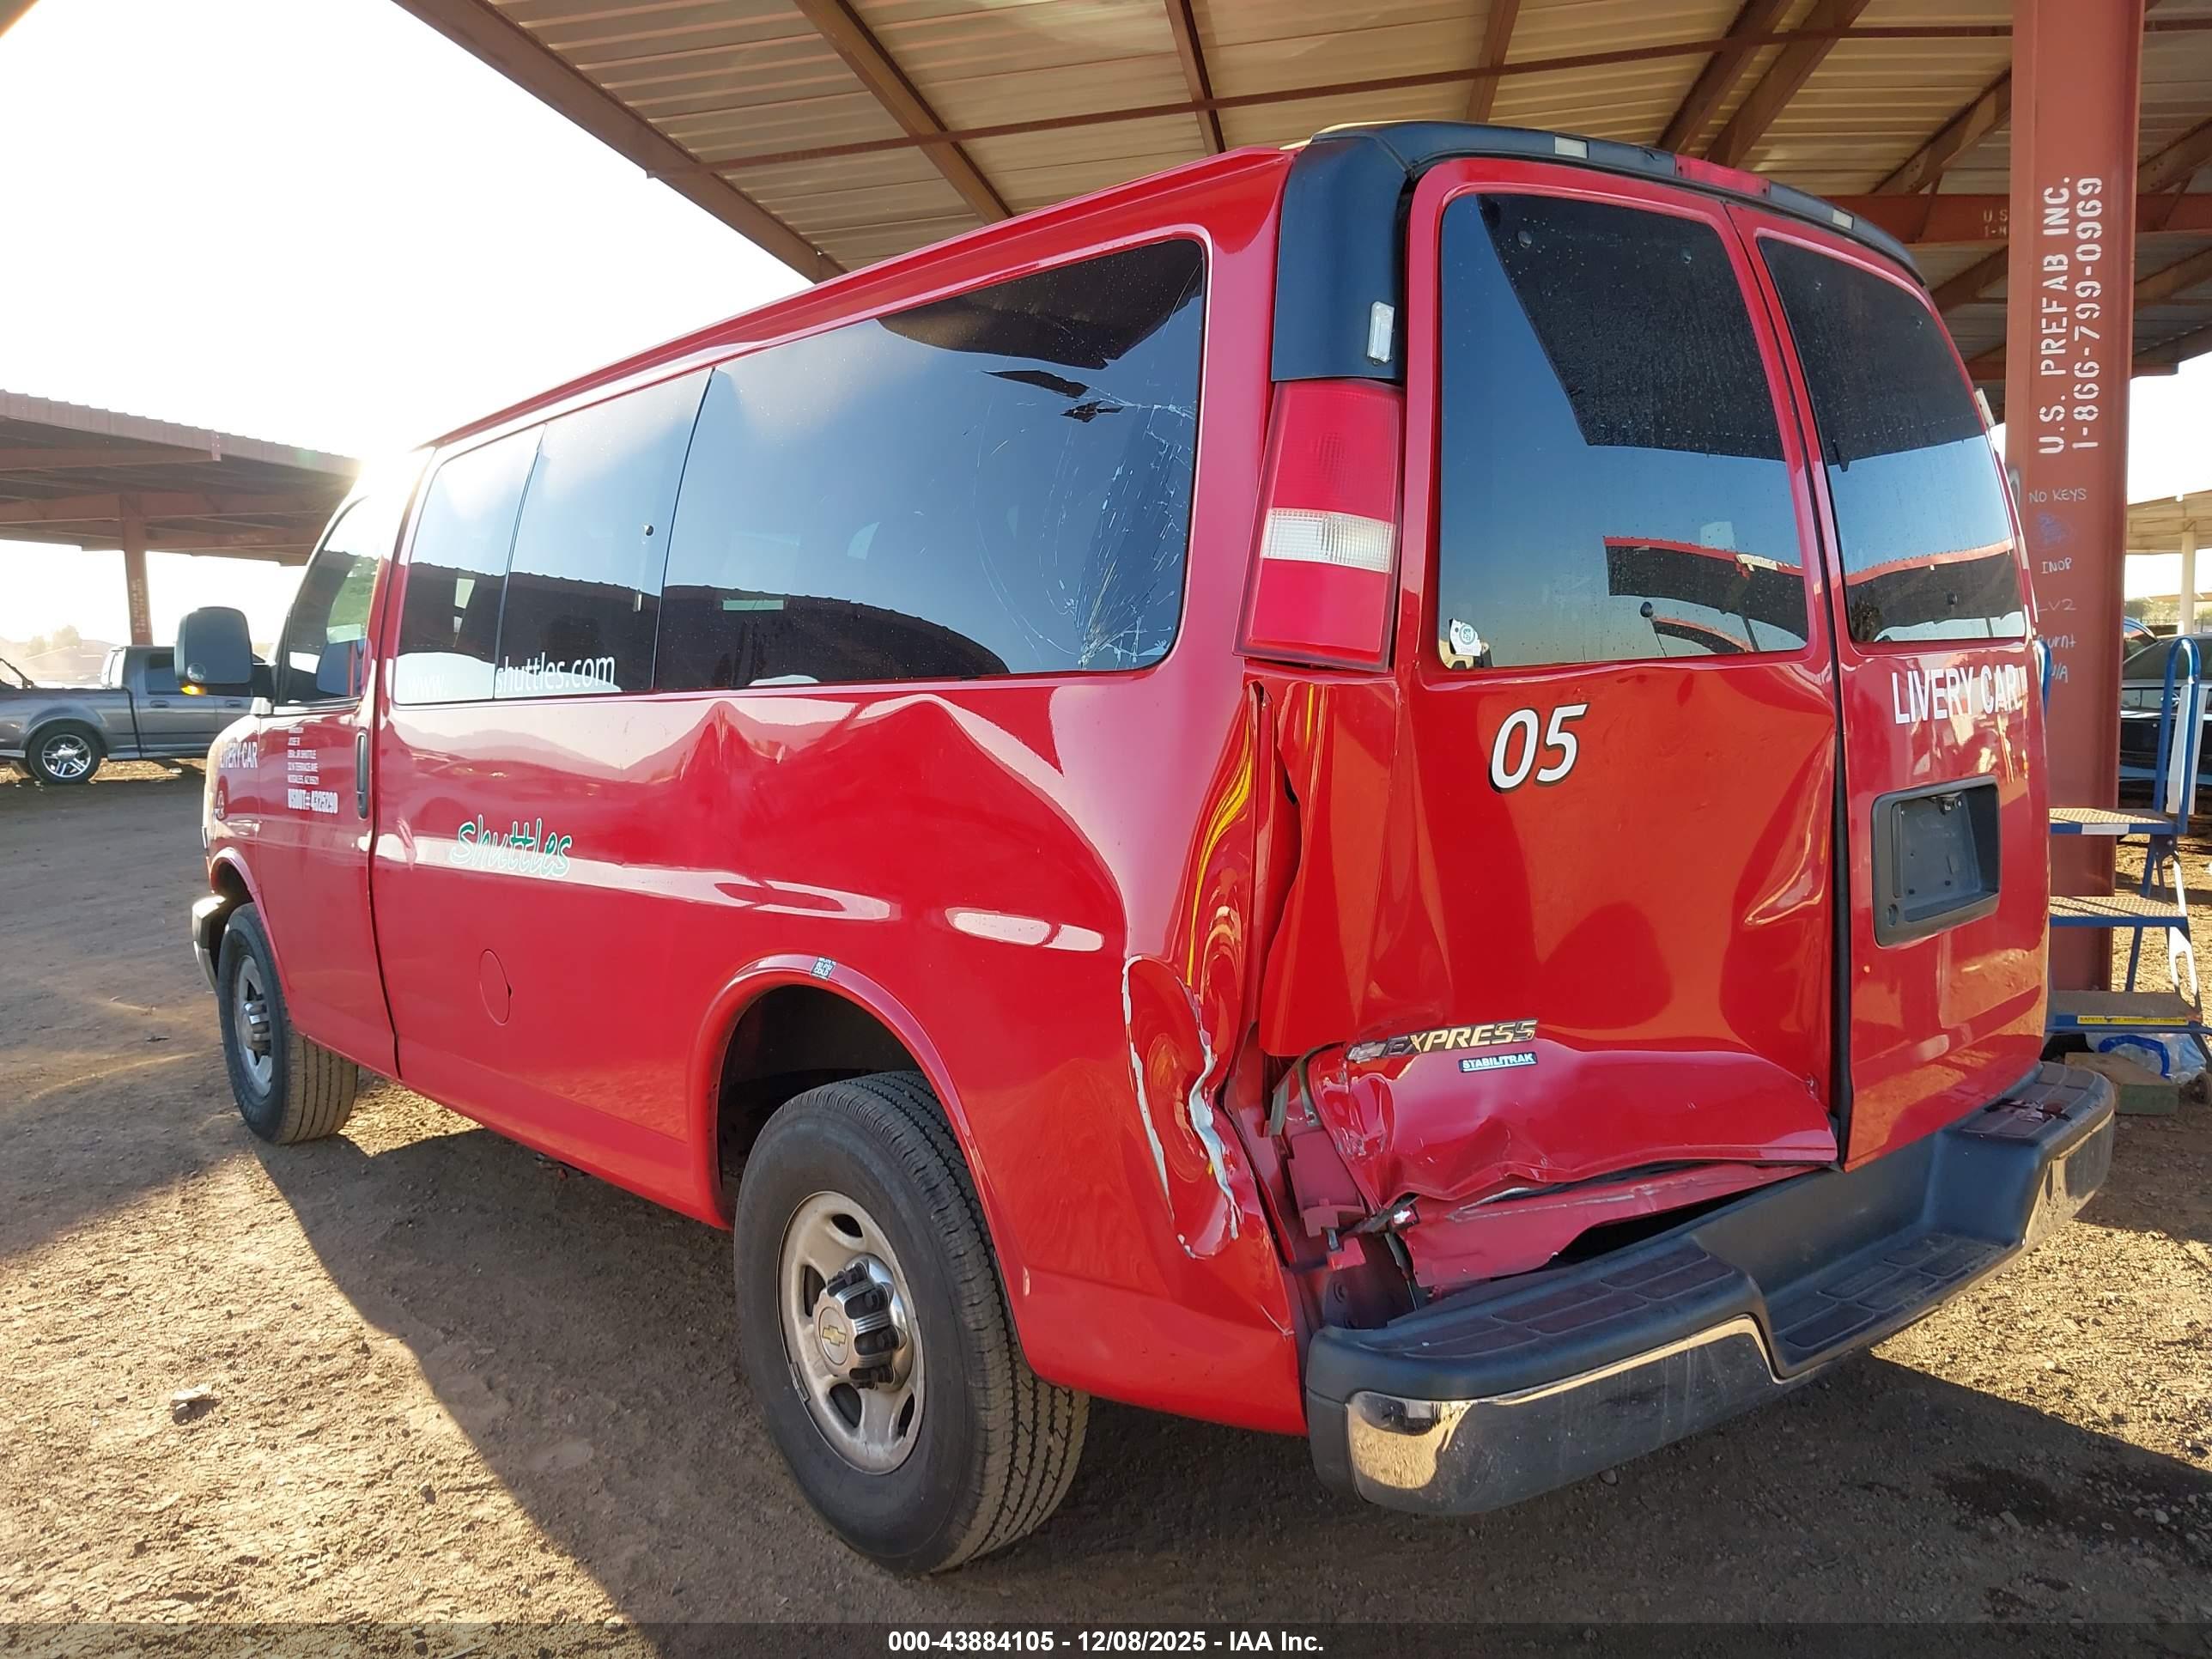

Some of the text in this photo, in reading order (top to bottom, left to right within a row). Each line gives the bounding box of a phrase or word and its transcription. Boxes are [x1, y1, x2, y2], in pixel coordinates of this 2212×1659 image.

[2039, 177, 2070, 454] U.S. PREFAB INC.
[2072, 177, 2103, 450] 1-866-799-0969
[2028, 488, 2087, 503] NO KEYS
[2041, 557, 2072, 574] INOP
[495, 652, 616, 694] shuttles.com
[1892, 666, 1974, 725] LIVERY
[1490, 703, 1588, 792] 05
[1385, 1019, 1538, 1057] EXPRESS
[1462, 1053, 1534, 1070] STABILITRAK
